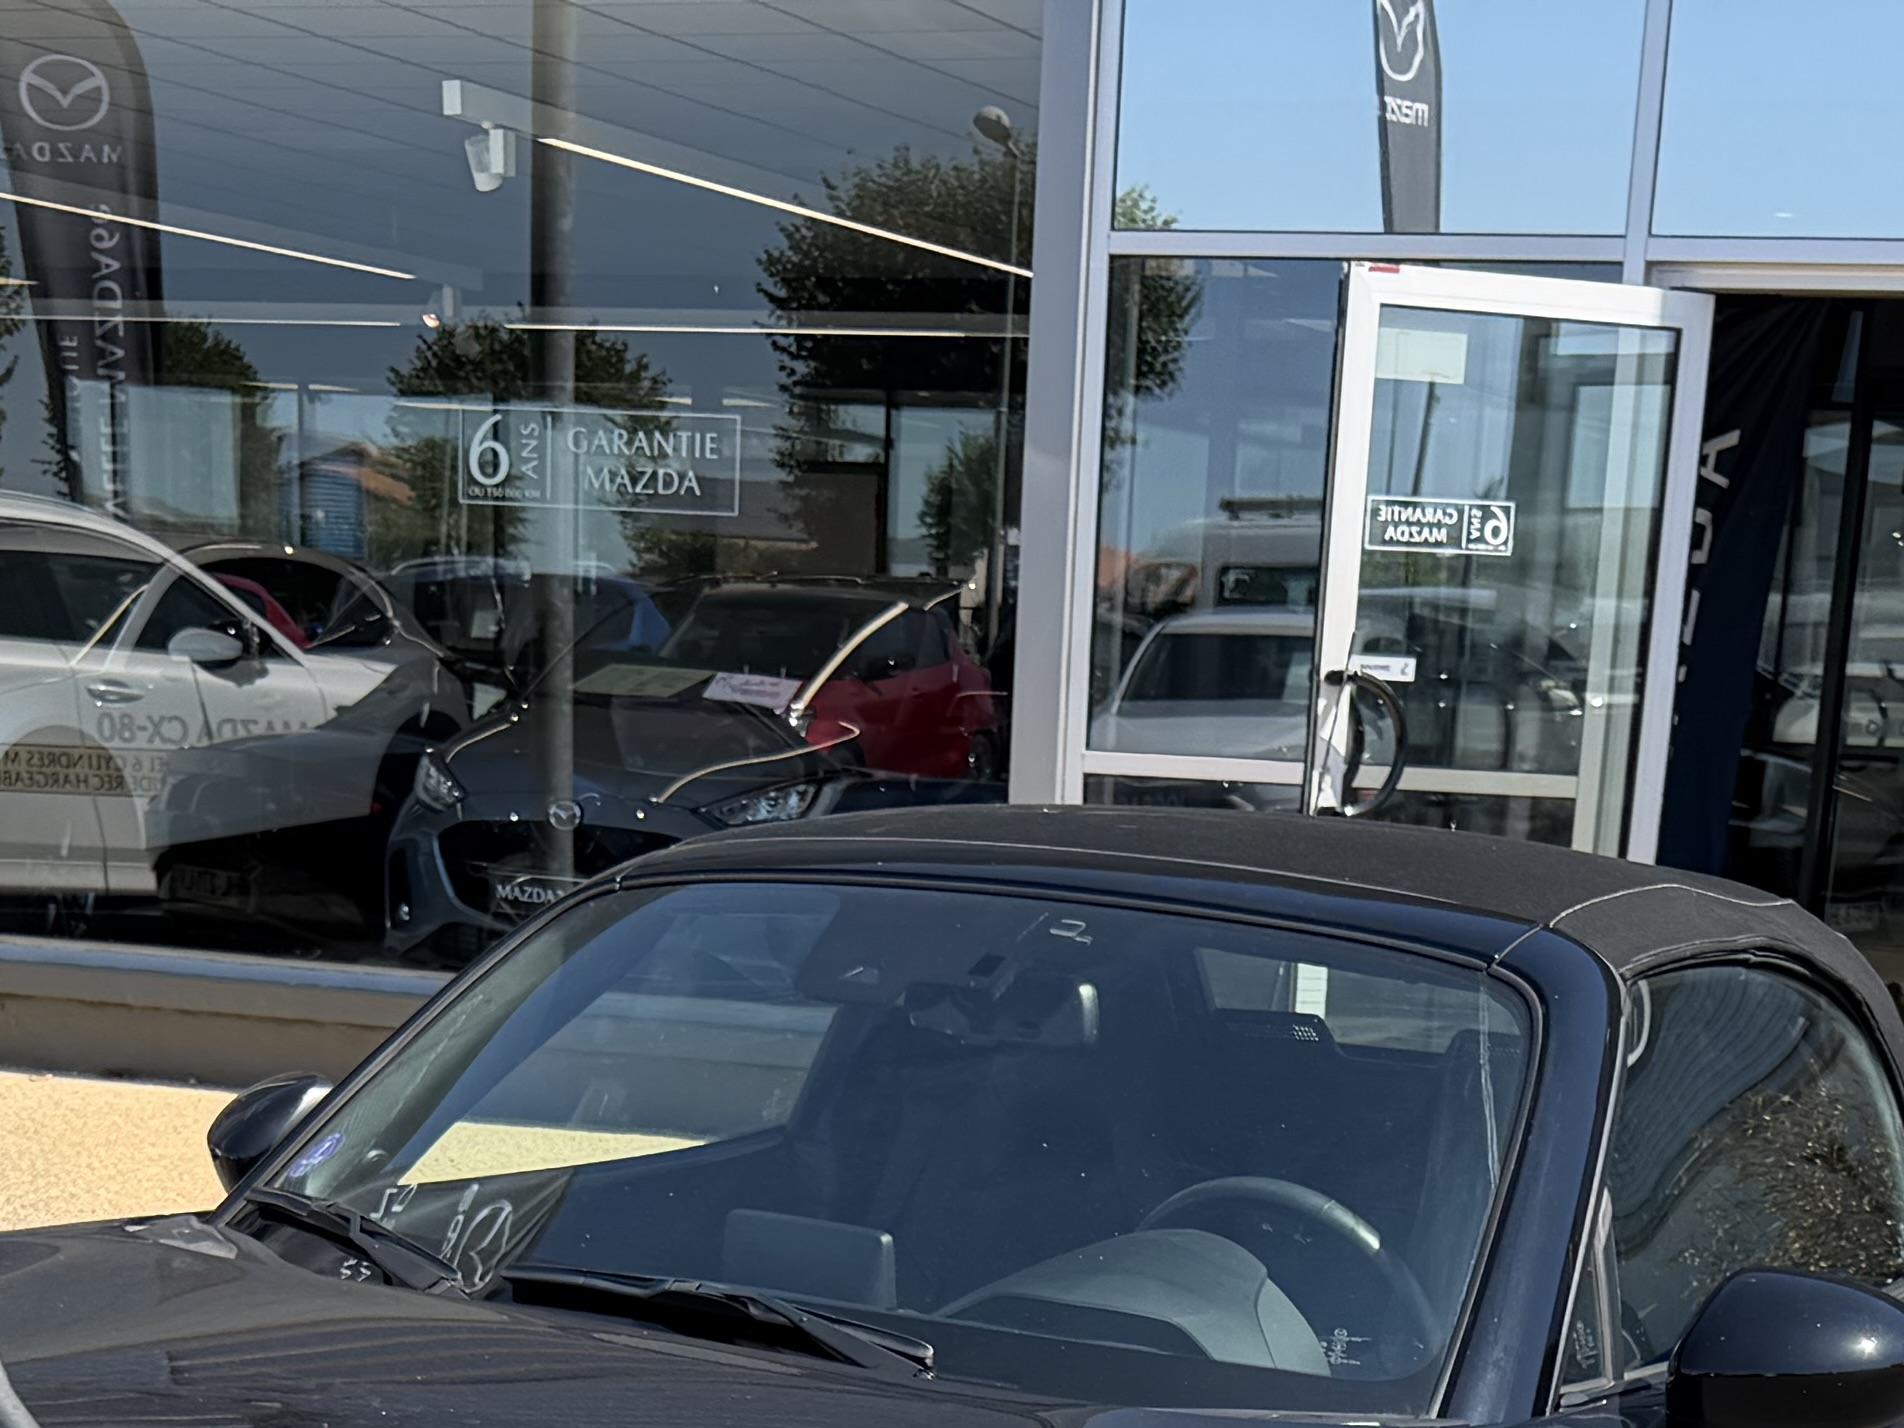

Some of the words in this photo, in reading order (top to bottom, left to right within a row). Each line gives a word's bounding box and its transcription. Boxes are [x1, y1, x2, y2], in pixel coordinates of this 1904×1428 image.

[468, 414, 511, 486] 6
[520, 423, 540, 479] ANS
[566, 427, 720, 460] GARANTIE
[584, 465, 702, 496] MAZDA
